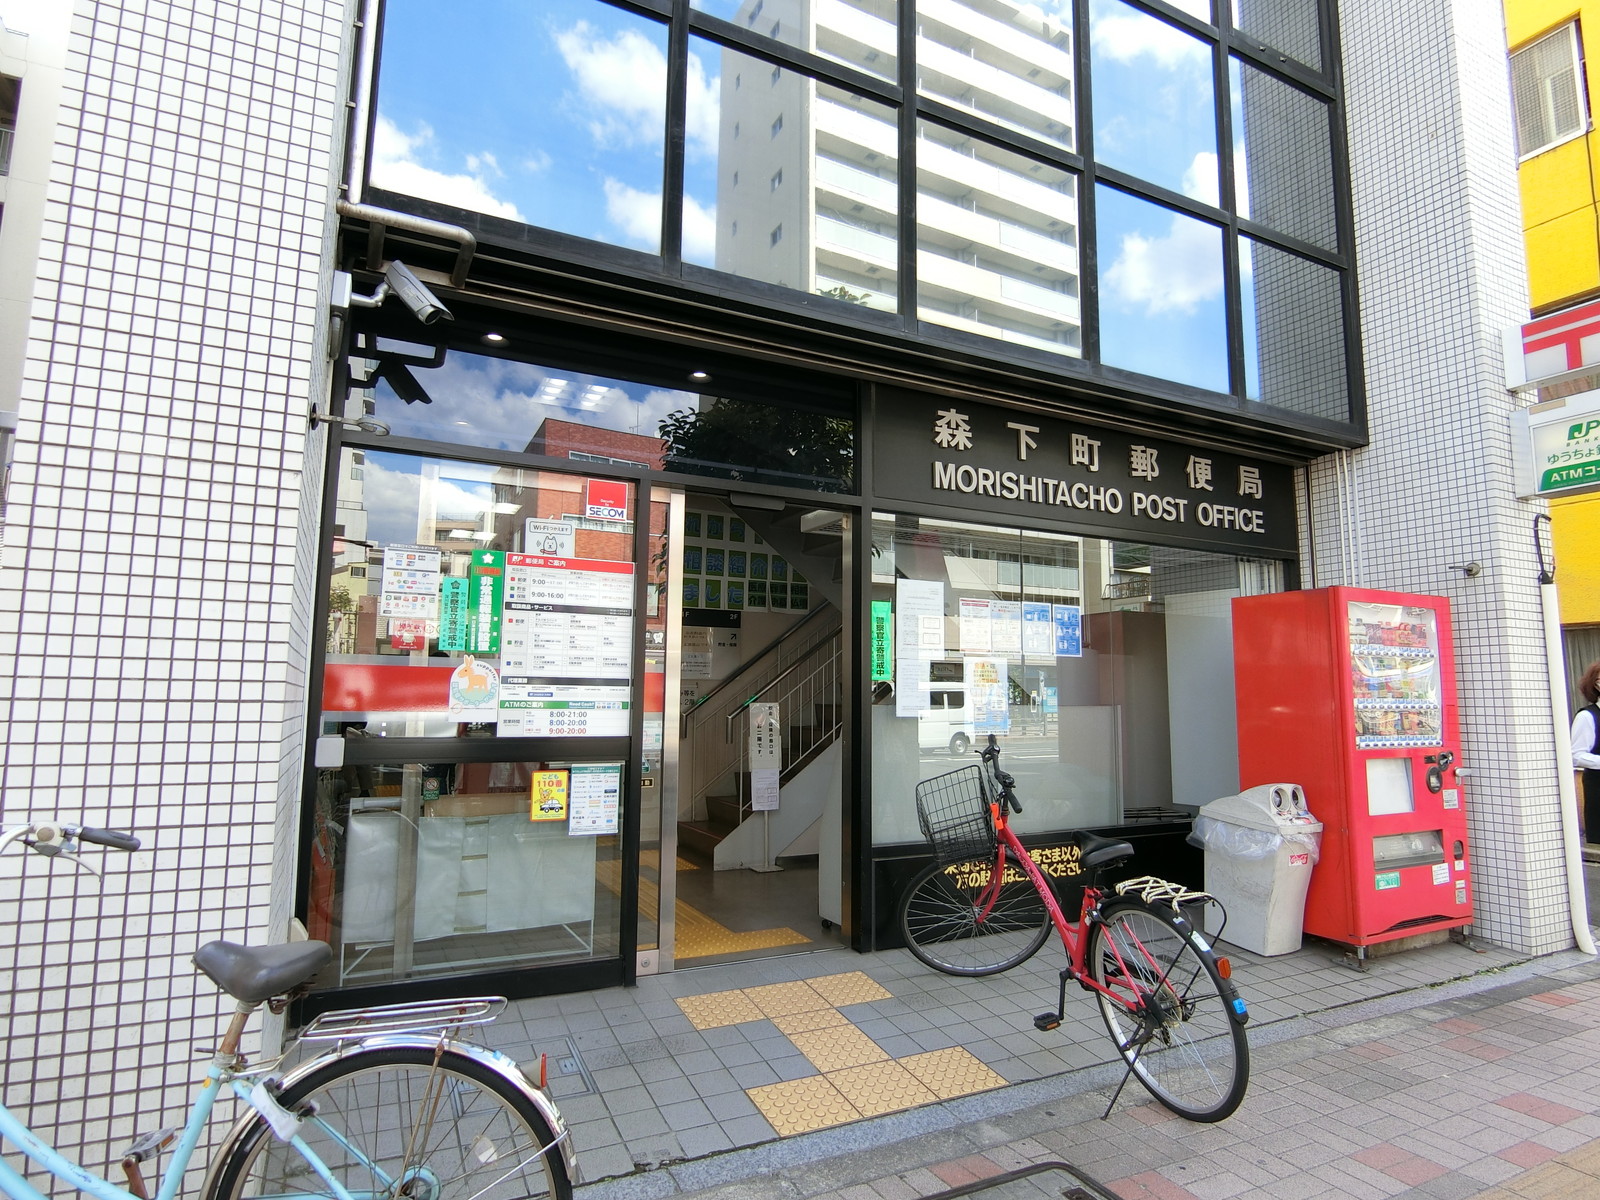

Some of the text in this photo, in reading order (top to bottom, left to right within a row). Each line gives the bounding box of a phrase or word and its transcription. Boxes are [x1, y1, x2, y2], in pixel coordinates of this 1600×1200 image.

[1566, 436, 1599, 448] BANK
[934, 408, 1263, 500] 森下町郵便局
[933, 461, 1265, 534] MORISHITACHO POST OFFICE
[589, 506, 624, 519] SECOM
[531, 591, 564, 599] 9:00-16:00
[448, 591, 460, 649] 警察官立寄警戒中
[876, 616, 885, 677] 警察官立寄警戒中
[504, 701, 544, 709] ATMのご案内
[548, 727, 587, 735] 9:00-20:00
[537, 780, 563, 788] 110番
